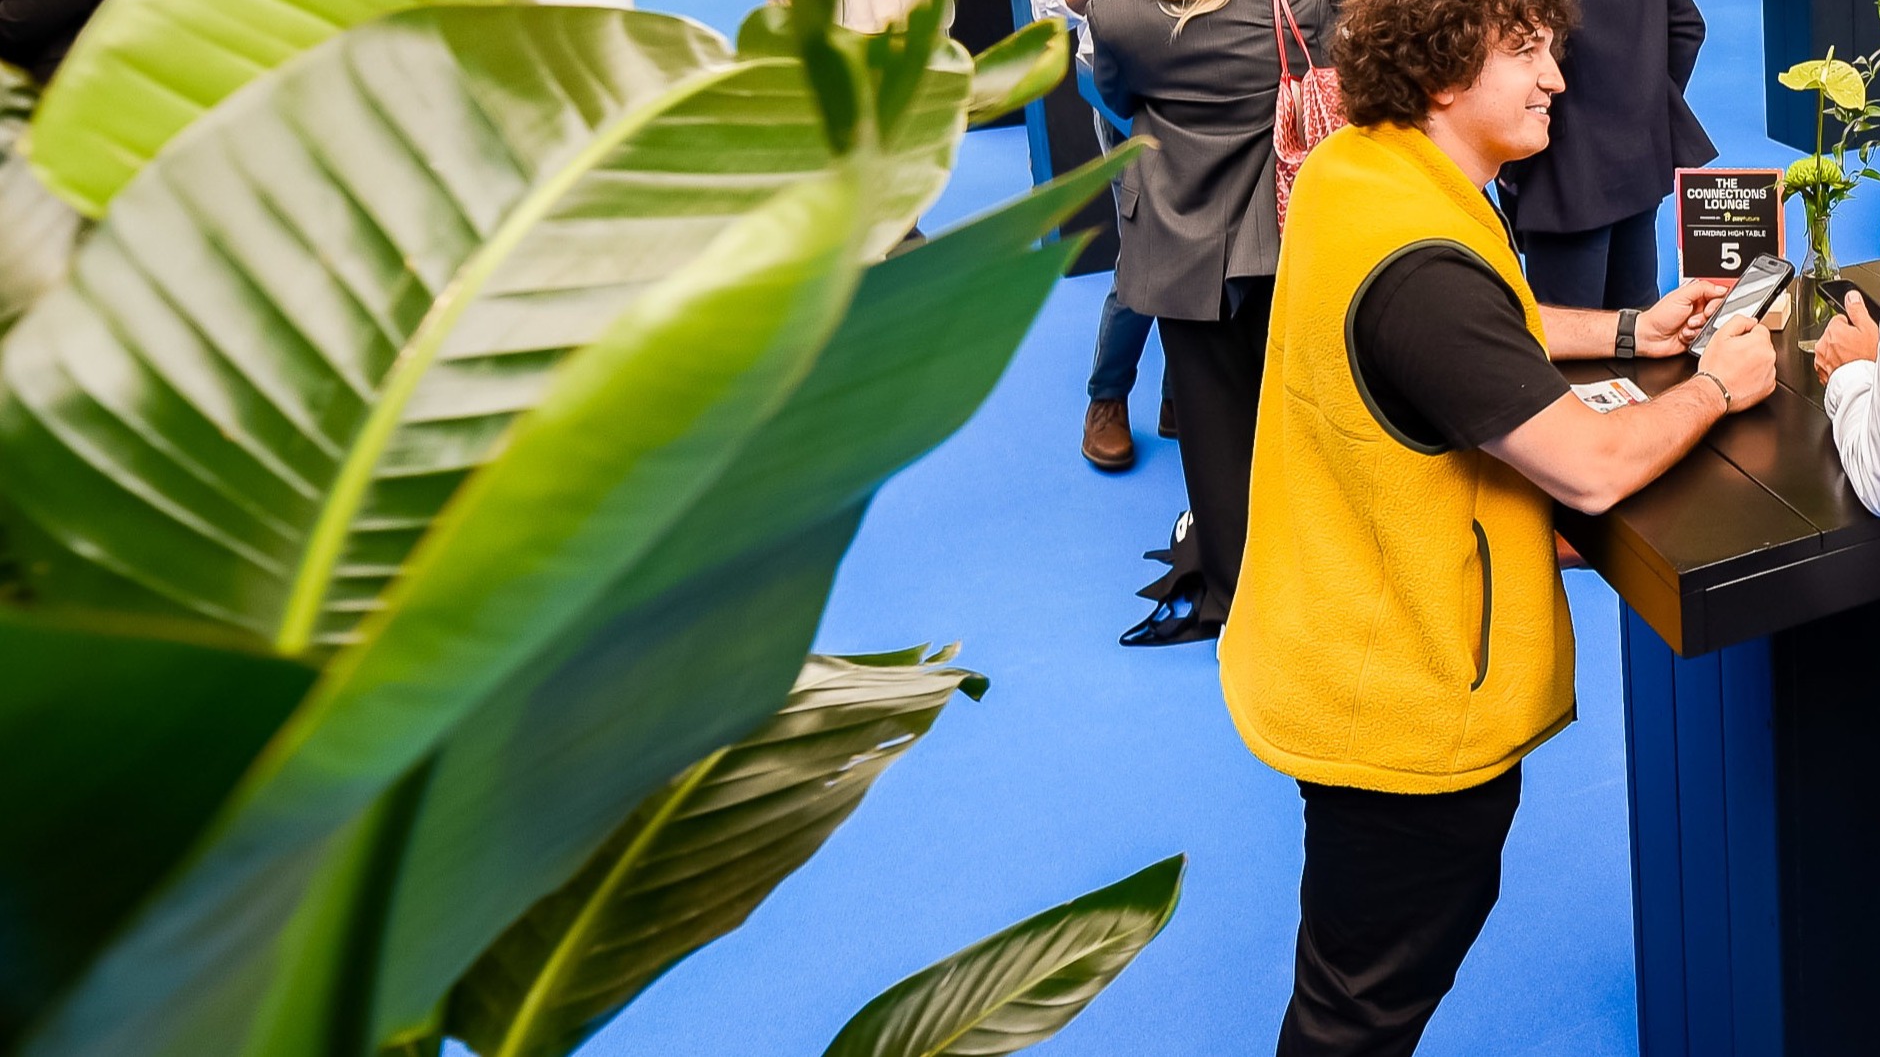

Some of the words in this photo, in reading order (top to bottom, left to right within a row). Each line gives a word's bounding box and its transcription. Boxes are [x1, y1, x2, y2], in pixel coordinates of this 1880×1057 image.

[1715, 178, 1738, 189] THE
[1687, 188, 1767, 199] CONNECTIONS
[1704, 199, 1750, 210] LOUNGE
[1720, 242, 1742, 270] 5
